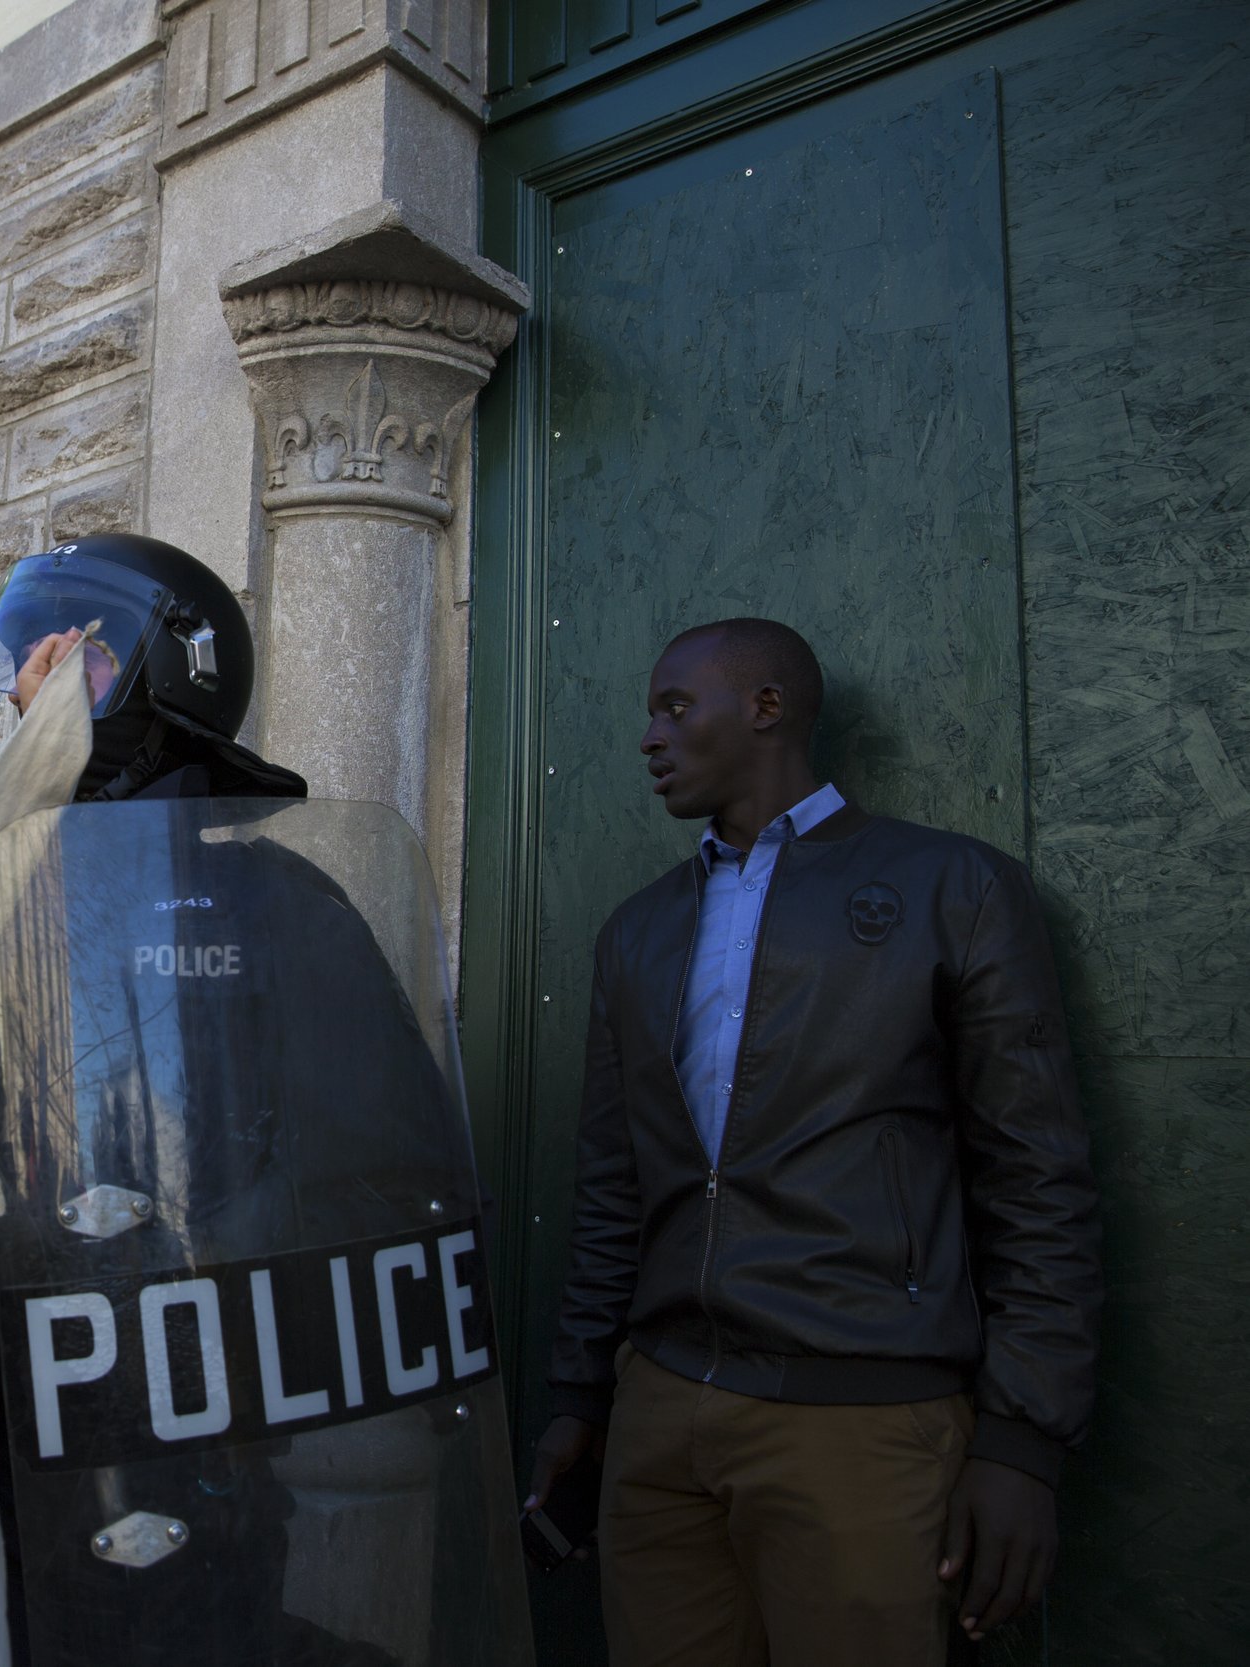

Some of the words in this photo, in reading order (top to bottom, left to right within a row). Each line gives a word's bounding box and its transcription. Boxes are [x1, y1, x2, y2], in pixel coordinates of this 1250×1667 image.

[154, 897, 213, 911] 3243
[134, 944, 241, 977] POLICE
[25, 1230, 490, 1459] POLICE
